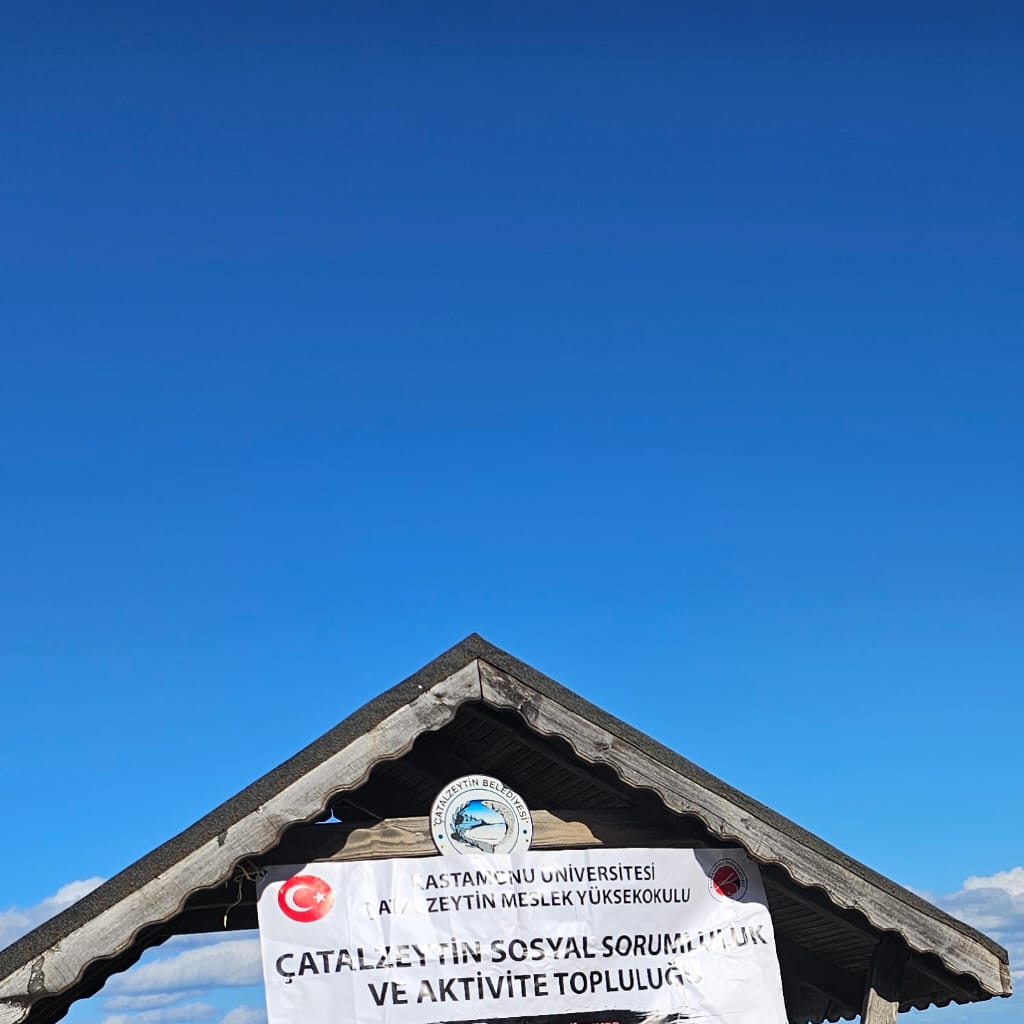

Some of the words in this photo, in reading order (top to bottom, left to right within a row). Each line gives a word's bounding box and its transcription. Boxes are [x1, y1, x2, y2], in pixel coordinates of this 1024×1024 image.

[502, 890, 574, 908] MESLEK
[576, 886, 690, 905] YÜKSEKOKULU
[275, 937, 482, 984] ÇATALZEYTİN
[490, 936, 596, 962] SOSYAL
[368, 981, 409, 1006] VE
[416, 970, 549, 1004] AKTİVİTE
